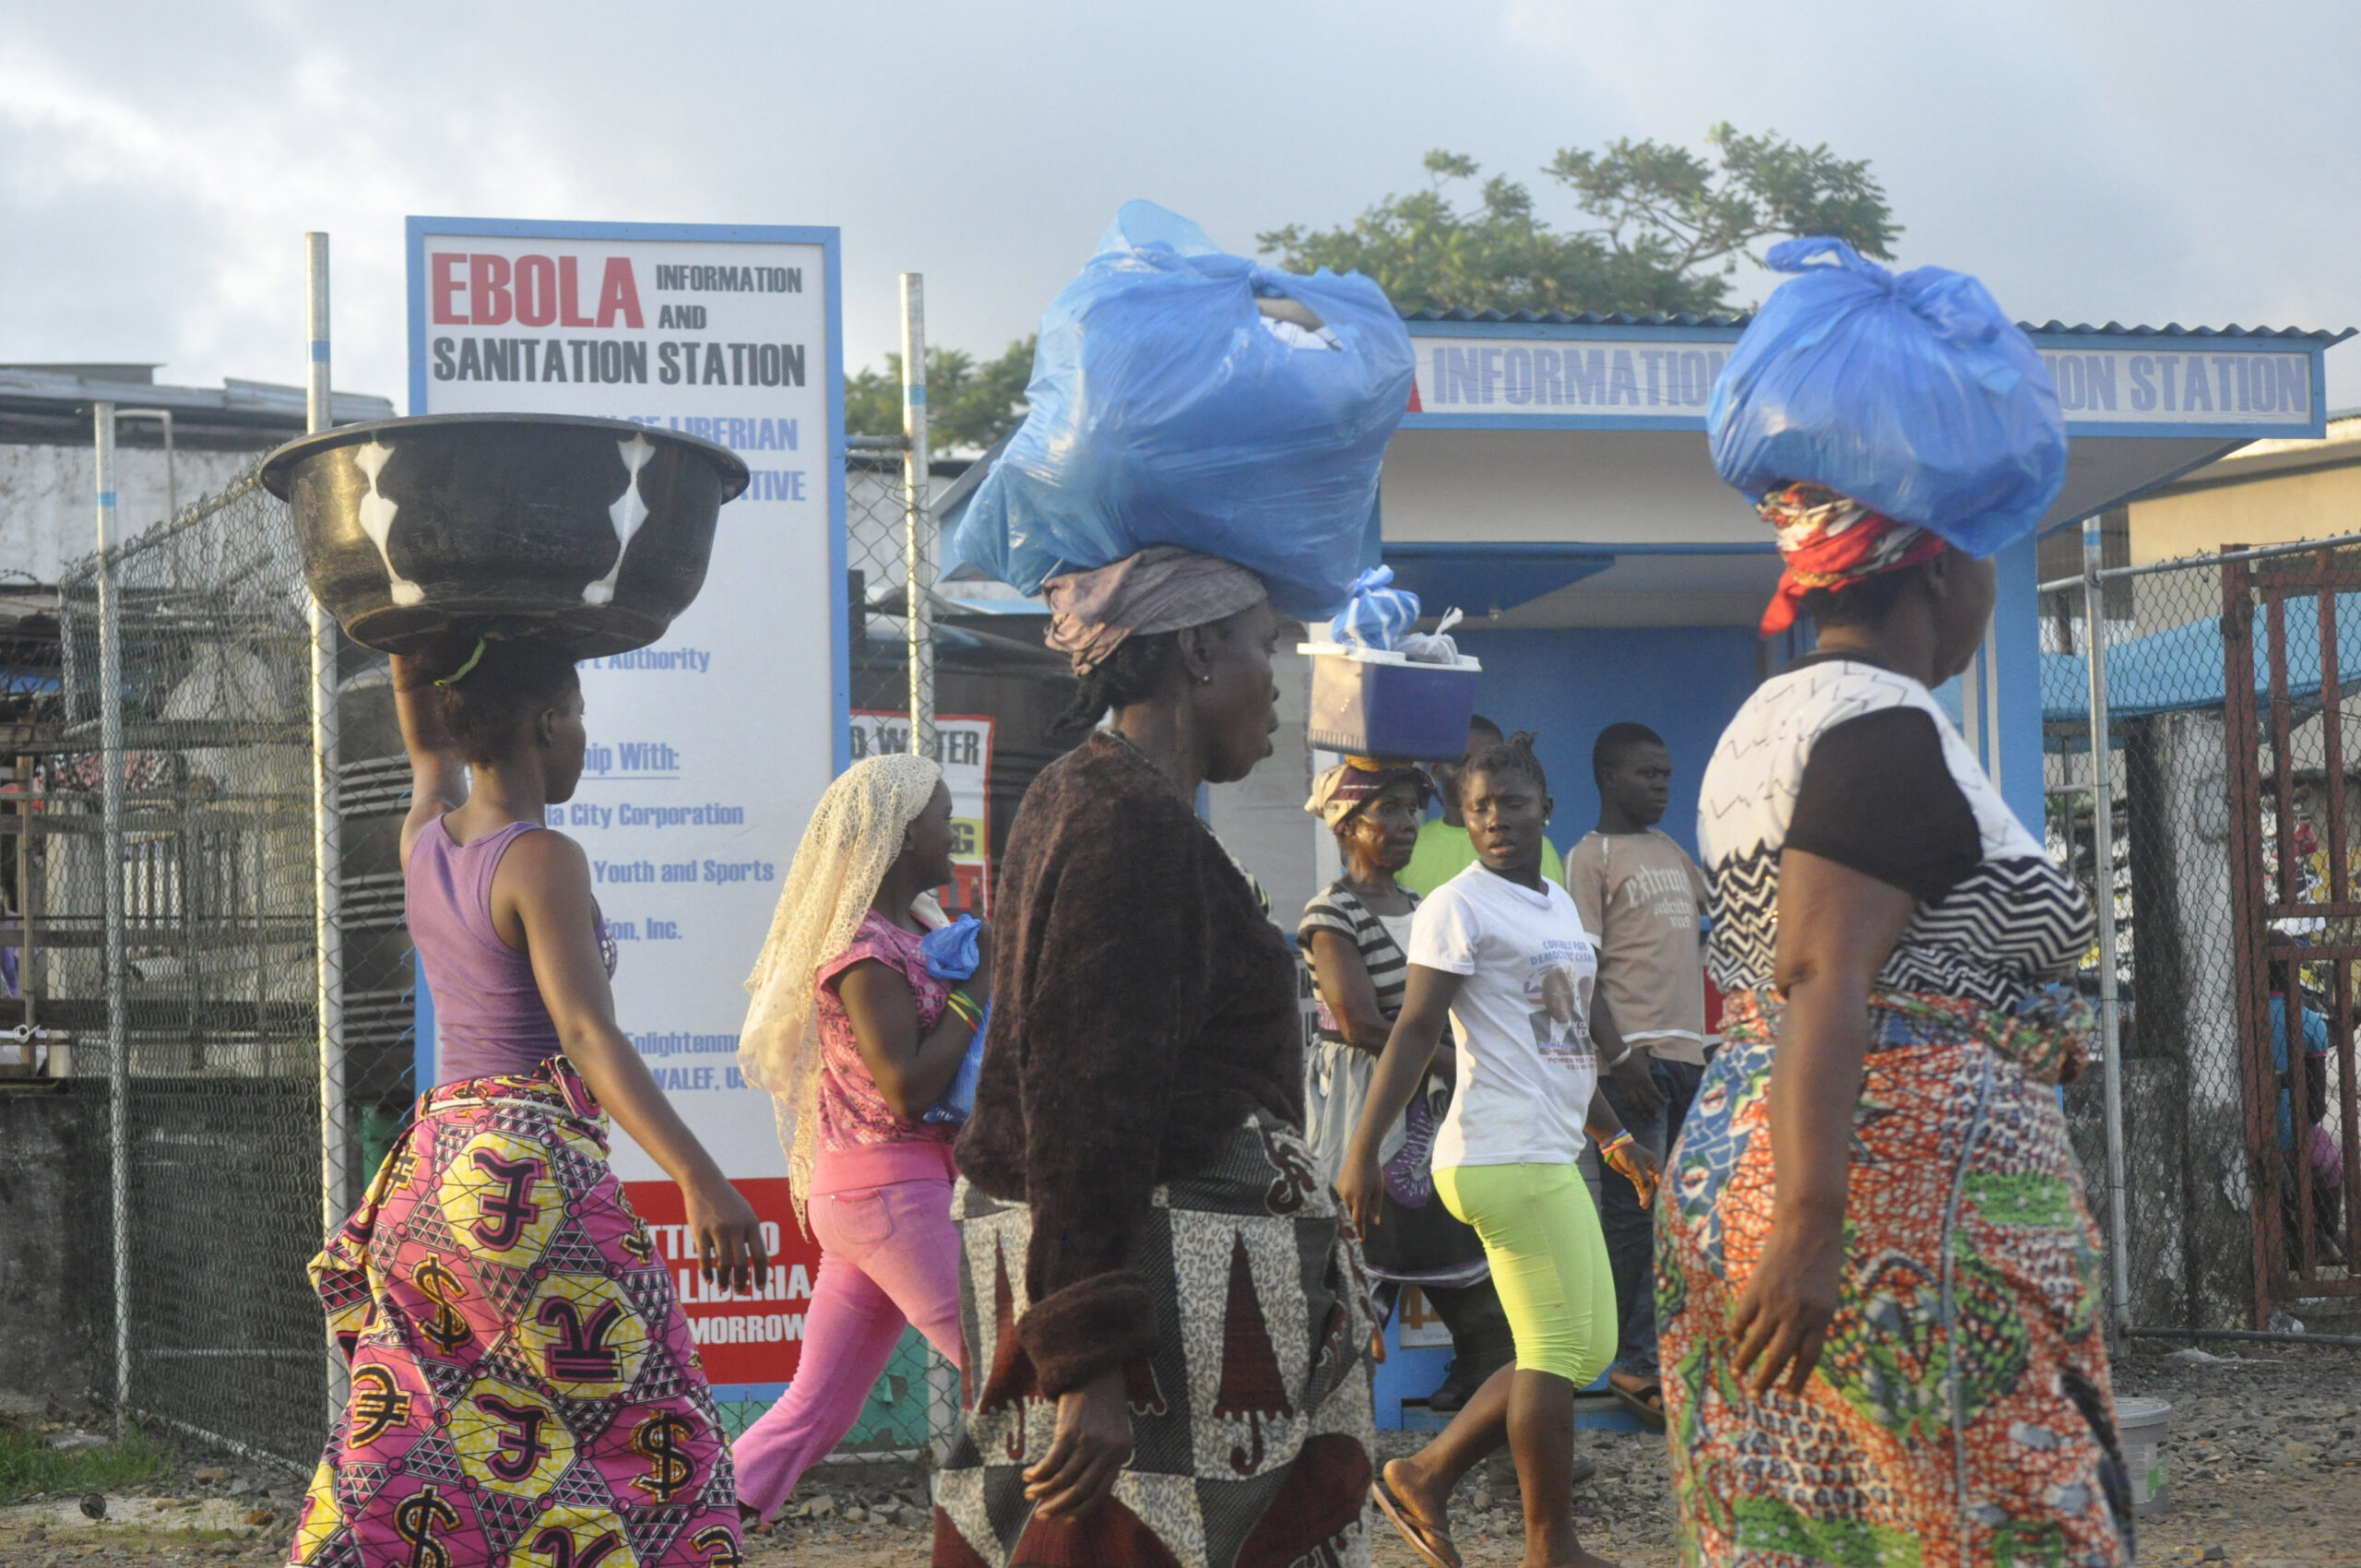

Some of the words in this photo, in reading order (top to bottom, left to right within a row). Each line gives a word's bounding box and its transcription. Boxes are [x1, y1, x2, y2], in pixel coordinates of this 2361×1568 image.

[432, 252, 645, 328] EBOLA
[656, 264, 802, 293] INFORMATION
[658, 304, 707, 329] AND
[433, 337, 647, 384] SANITATION
[658, 341, 805, 386] STATION
[2129, 355, 2307, 412] STATION
[609, 647, 710, 673] Authority
[618, 742, 680, 771] With:
[876, 726, 979, 766] WTER
[570, 802, 612, 830] City
[619, 802, 744, 828] Corporation
[593, 860, 655, 883] Youth
[661, 860, 697, 883] and
[703, 859, 775, 885] Sports
[646, 917, 682, 940] Inc.
[623, 1031, 741, 1058] nlightenm
[687, 1313, 809, 1345] MORROW
